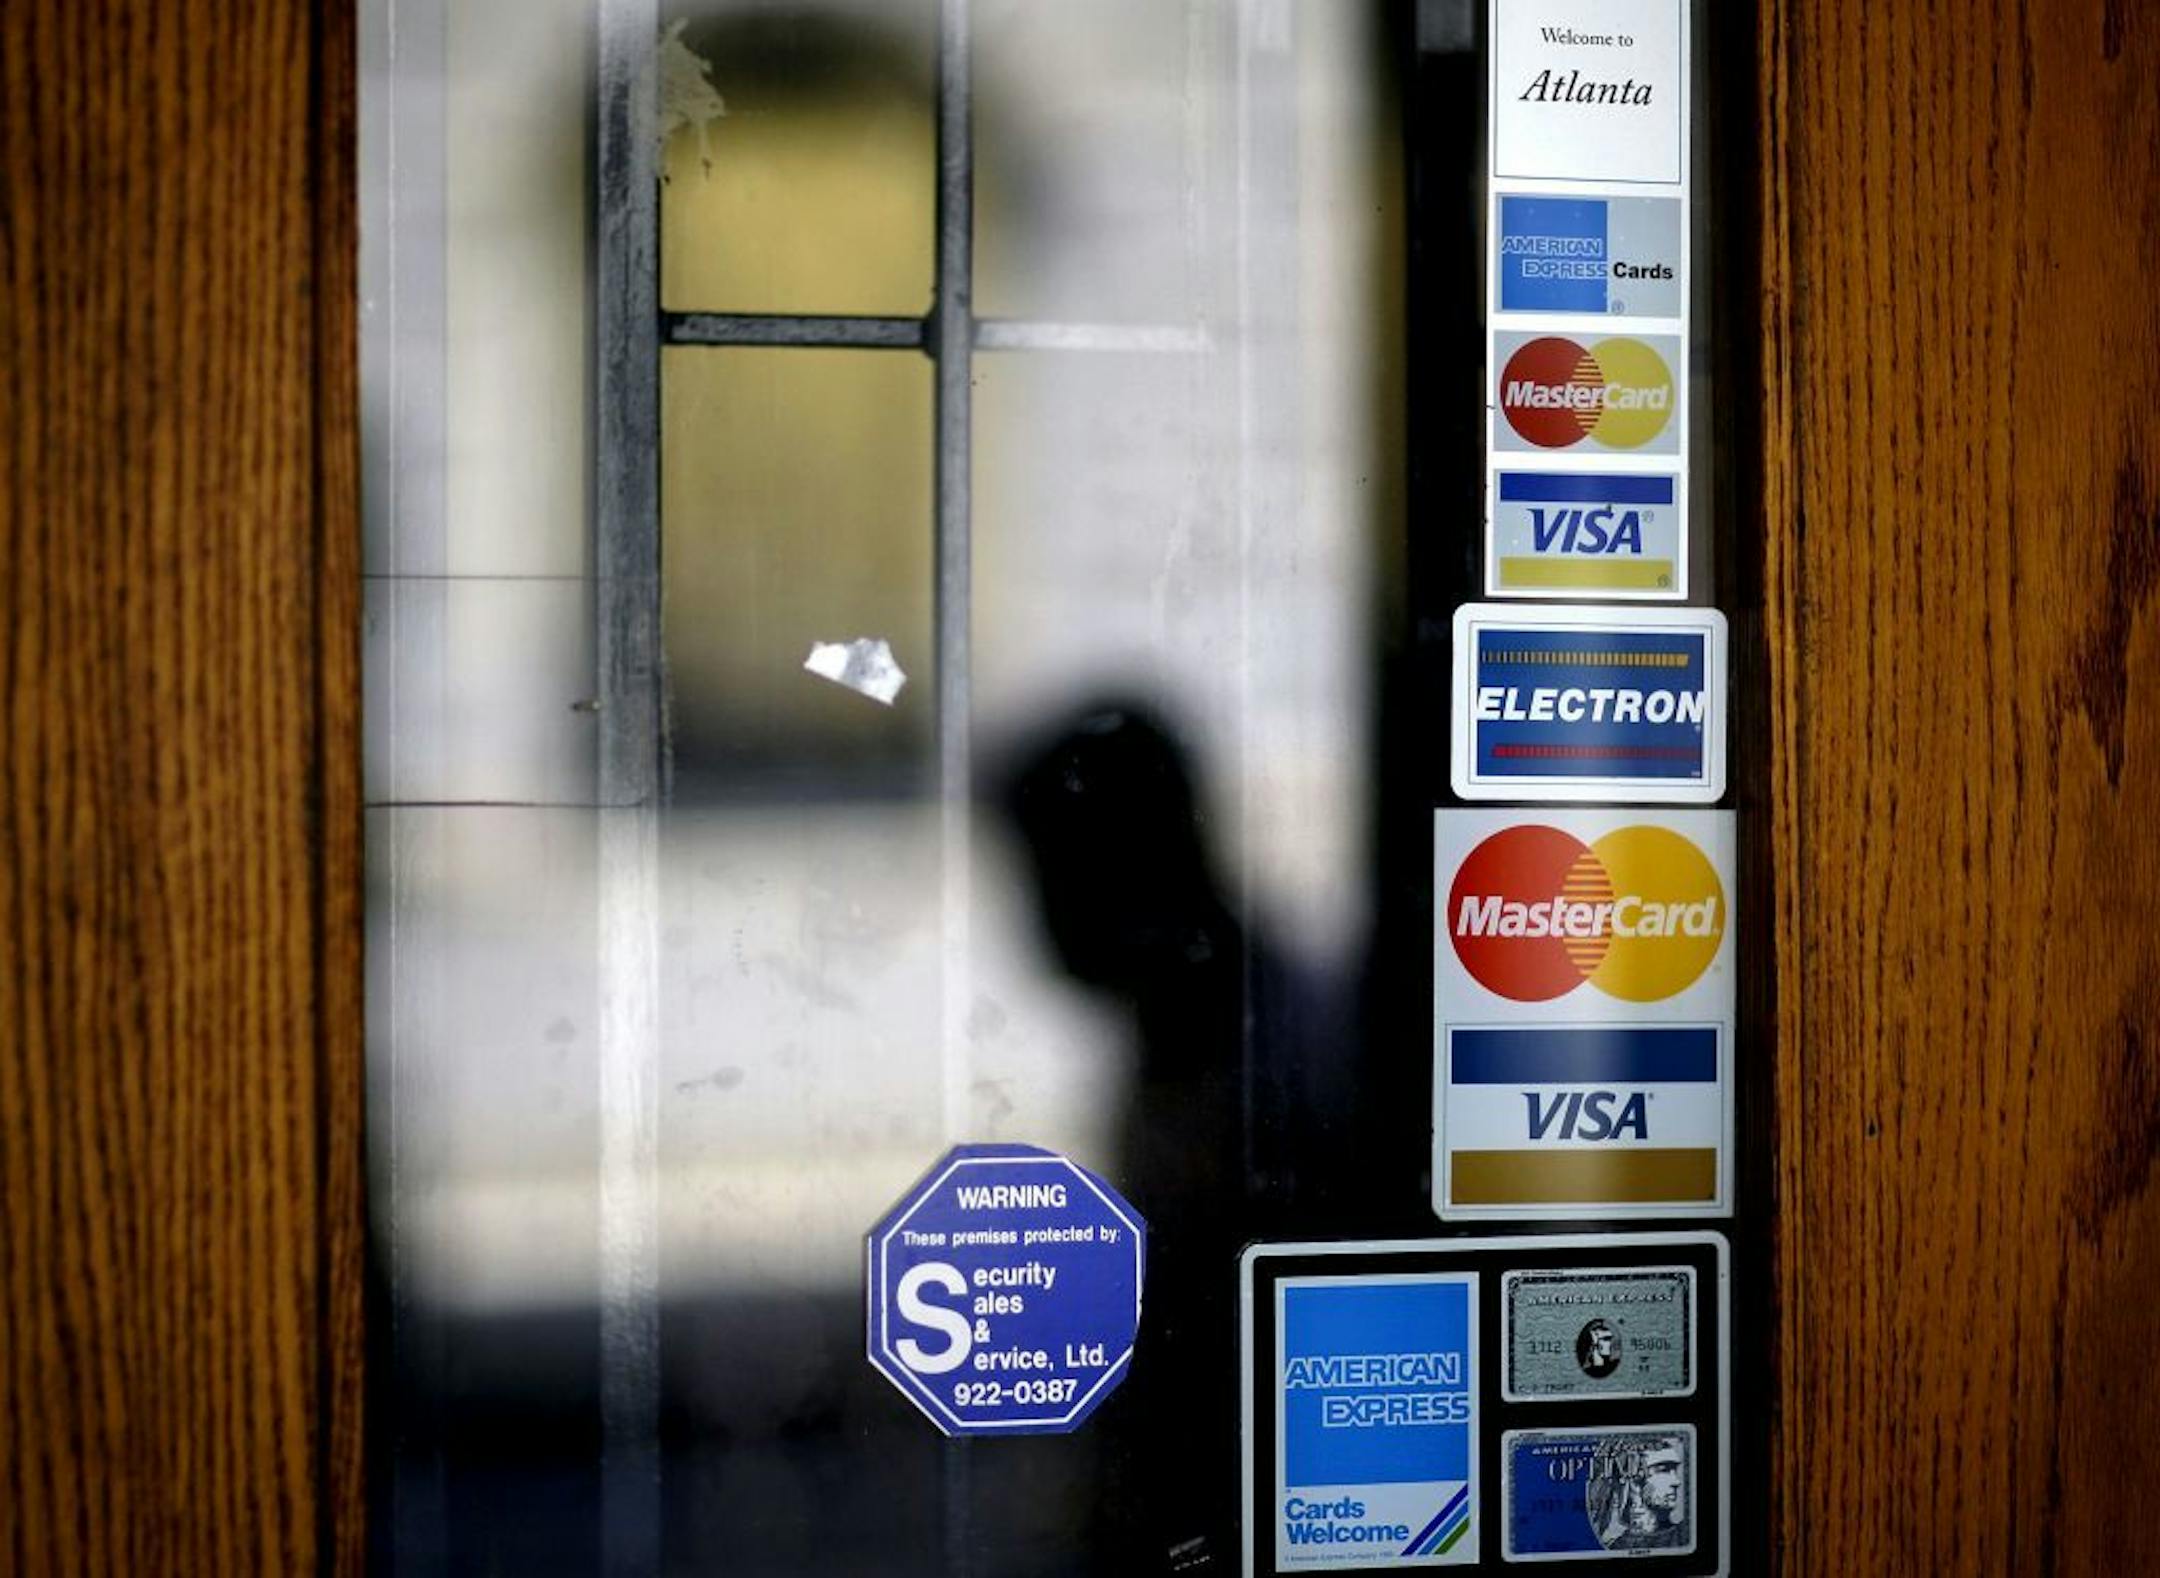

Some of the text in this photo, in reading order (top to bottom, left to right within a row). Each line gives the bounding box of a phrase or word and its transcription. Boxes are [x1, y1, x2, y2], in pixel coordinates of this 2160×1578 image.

[1540, 27, 1634, 47] Welcome to
[1519, 70, 1653, 106] Atlanta
[1501, 236, 1601, 256] AMERICAN
[1522, 259, 1607, 278] EXPRESS
[1613, 262, 1673, 280] Cards
[1505, 381, 1669, 409] MasterCard
[1526, 508, 1642, 553] VISA
[1477, 687, 1705, 723] ELECTRON
[1457, 896, 1717, 938] MasterCard
[1521, 1092, 1648, 1140] VISA
[957, 1185, 1066, 1209] WARNING
[903, 1225, 1121, 1247] These premises protected by:
[974, 1319, 990, 1343] &
[1066, 1343, 1109, 1368] Ltd.
[1285, 1353, 1460, 1389] AMERICAN
[954, 1379, 1078, 1406] 922-0387
[1322, 1392, 1469, 1427] EXPRESS
[1285, 1496, 1366, 1522] Cards
[1286, 1522, 1409, 1545] Welcome
